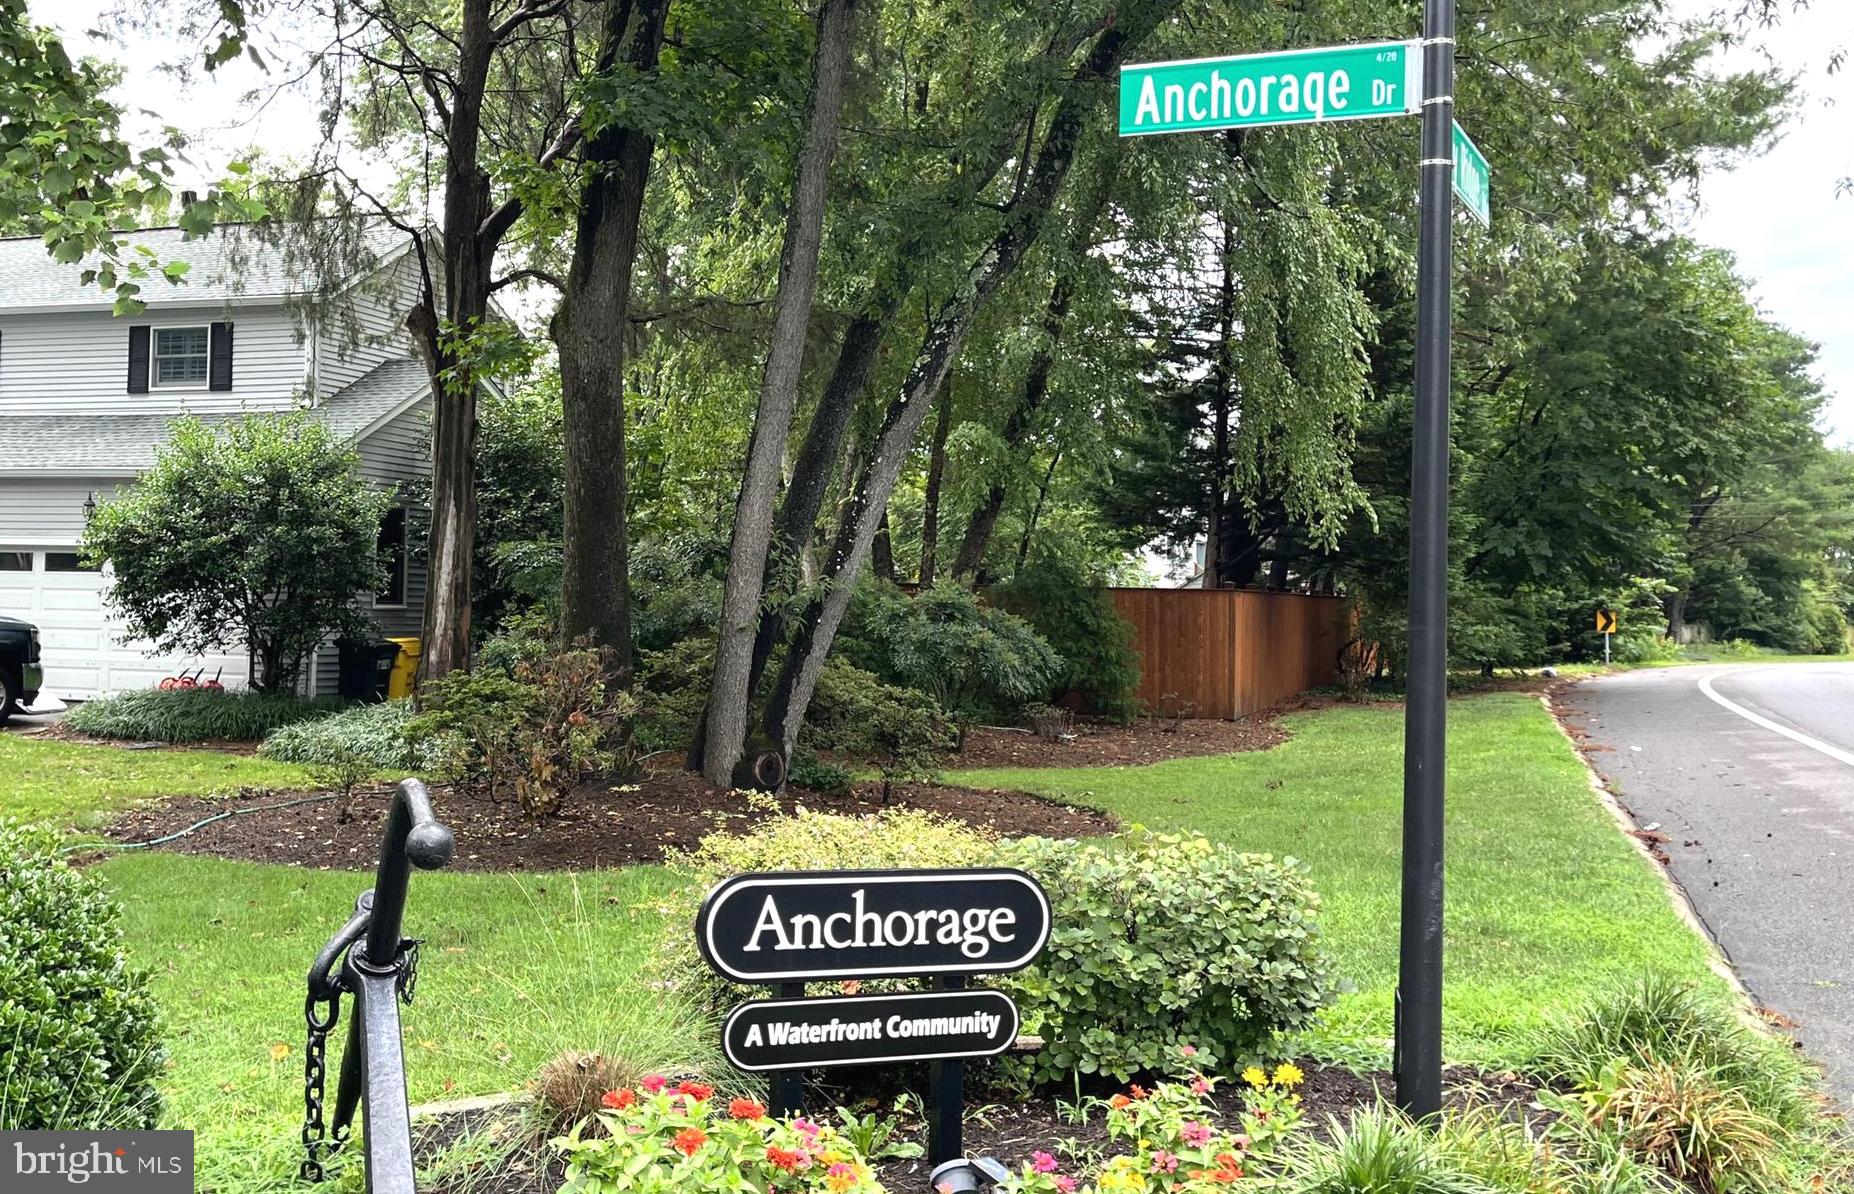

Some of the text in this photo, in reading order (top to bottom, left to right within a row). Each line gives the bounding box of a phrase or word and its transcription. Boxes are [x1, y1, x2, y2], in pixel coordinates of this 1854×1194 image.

[1376, 51, 1398, 62] 4/20
[1134, 69, 1397, 125] Anchorage Dr
[743, 889, 1016, 958] Anchorage
[744, 1011, 1001, 1047] A Waterfront Community
